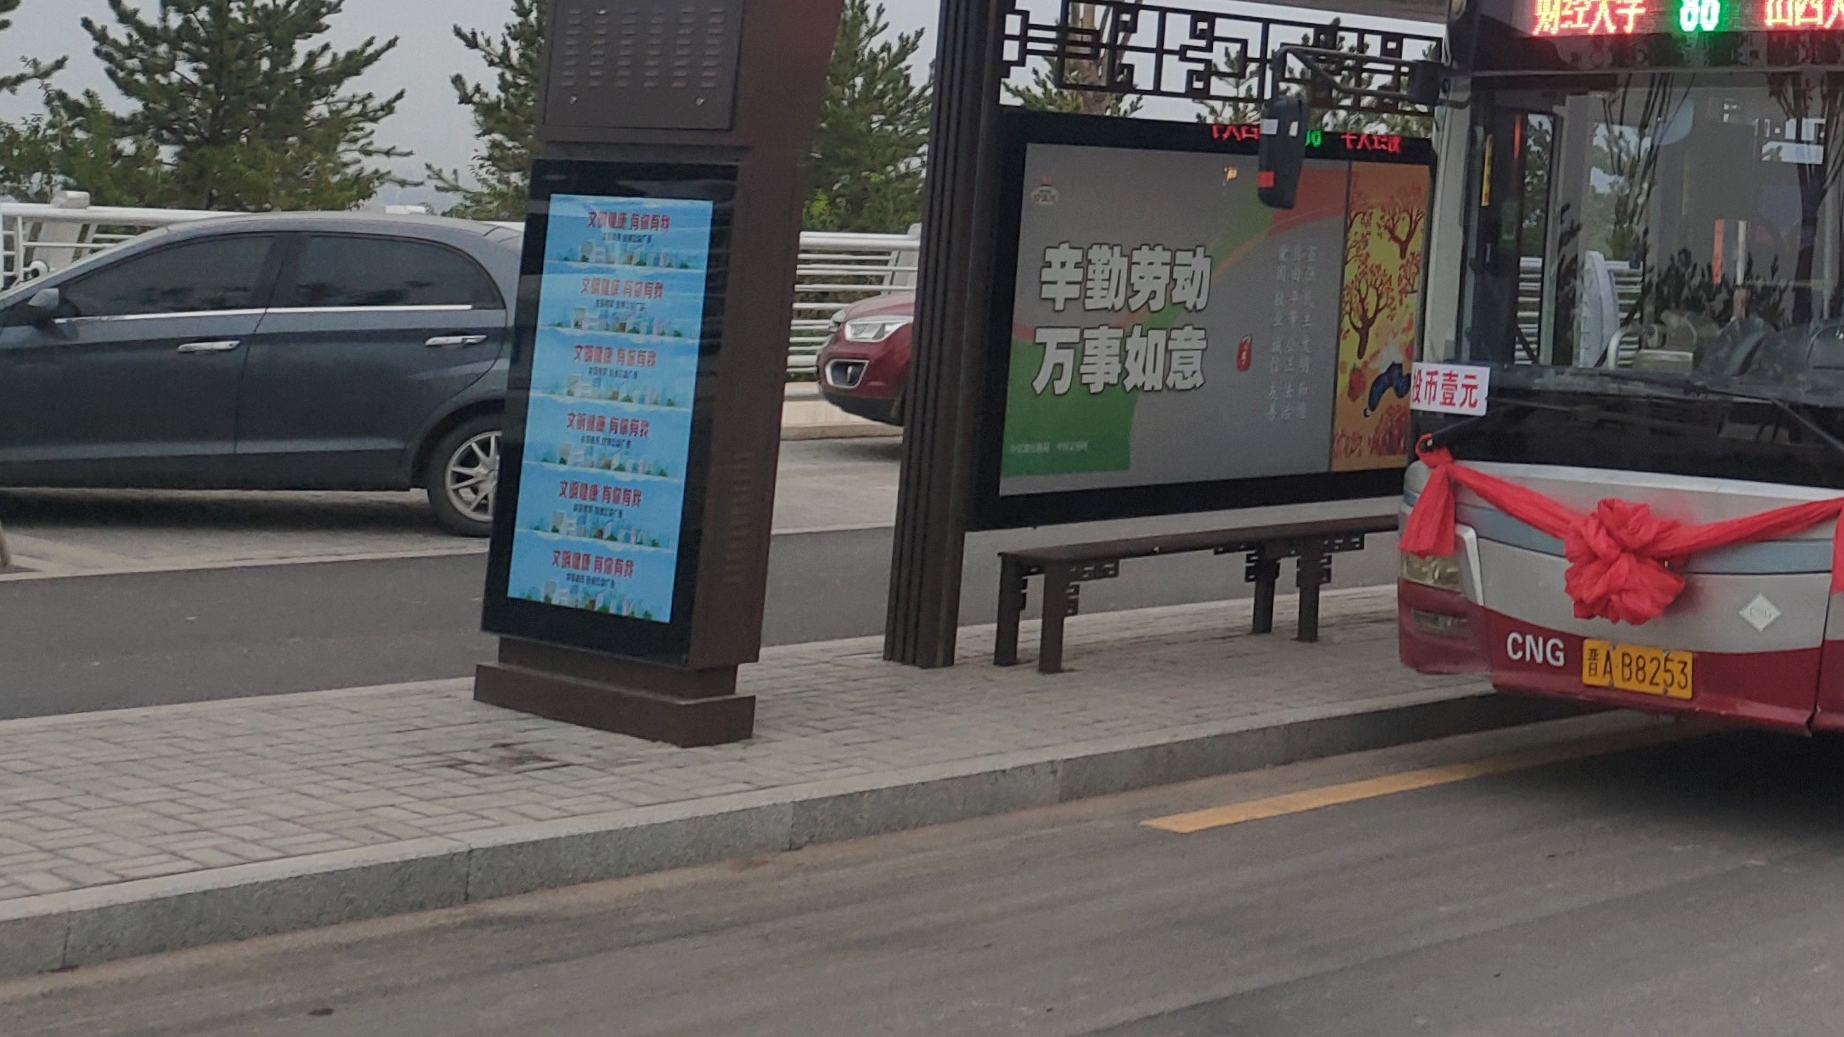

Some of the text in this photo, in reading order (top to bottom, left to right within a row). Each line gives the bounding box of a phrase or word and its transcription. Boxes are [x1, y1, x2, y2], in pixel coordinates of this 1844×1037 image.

[1041, 240, 1212, 312] 辛勤劳动
[1032, 324, 1208, 396] 万事如意
[1412, 368, 1480, 409] 投币壹元
[1507, 631, 1565, 667] CNG
